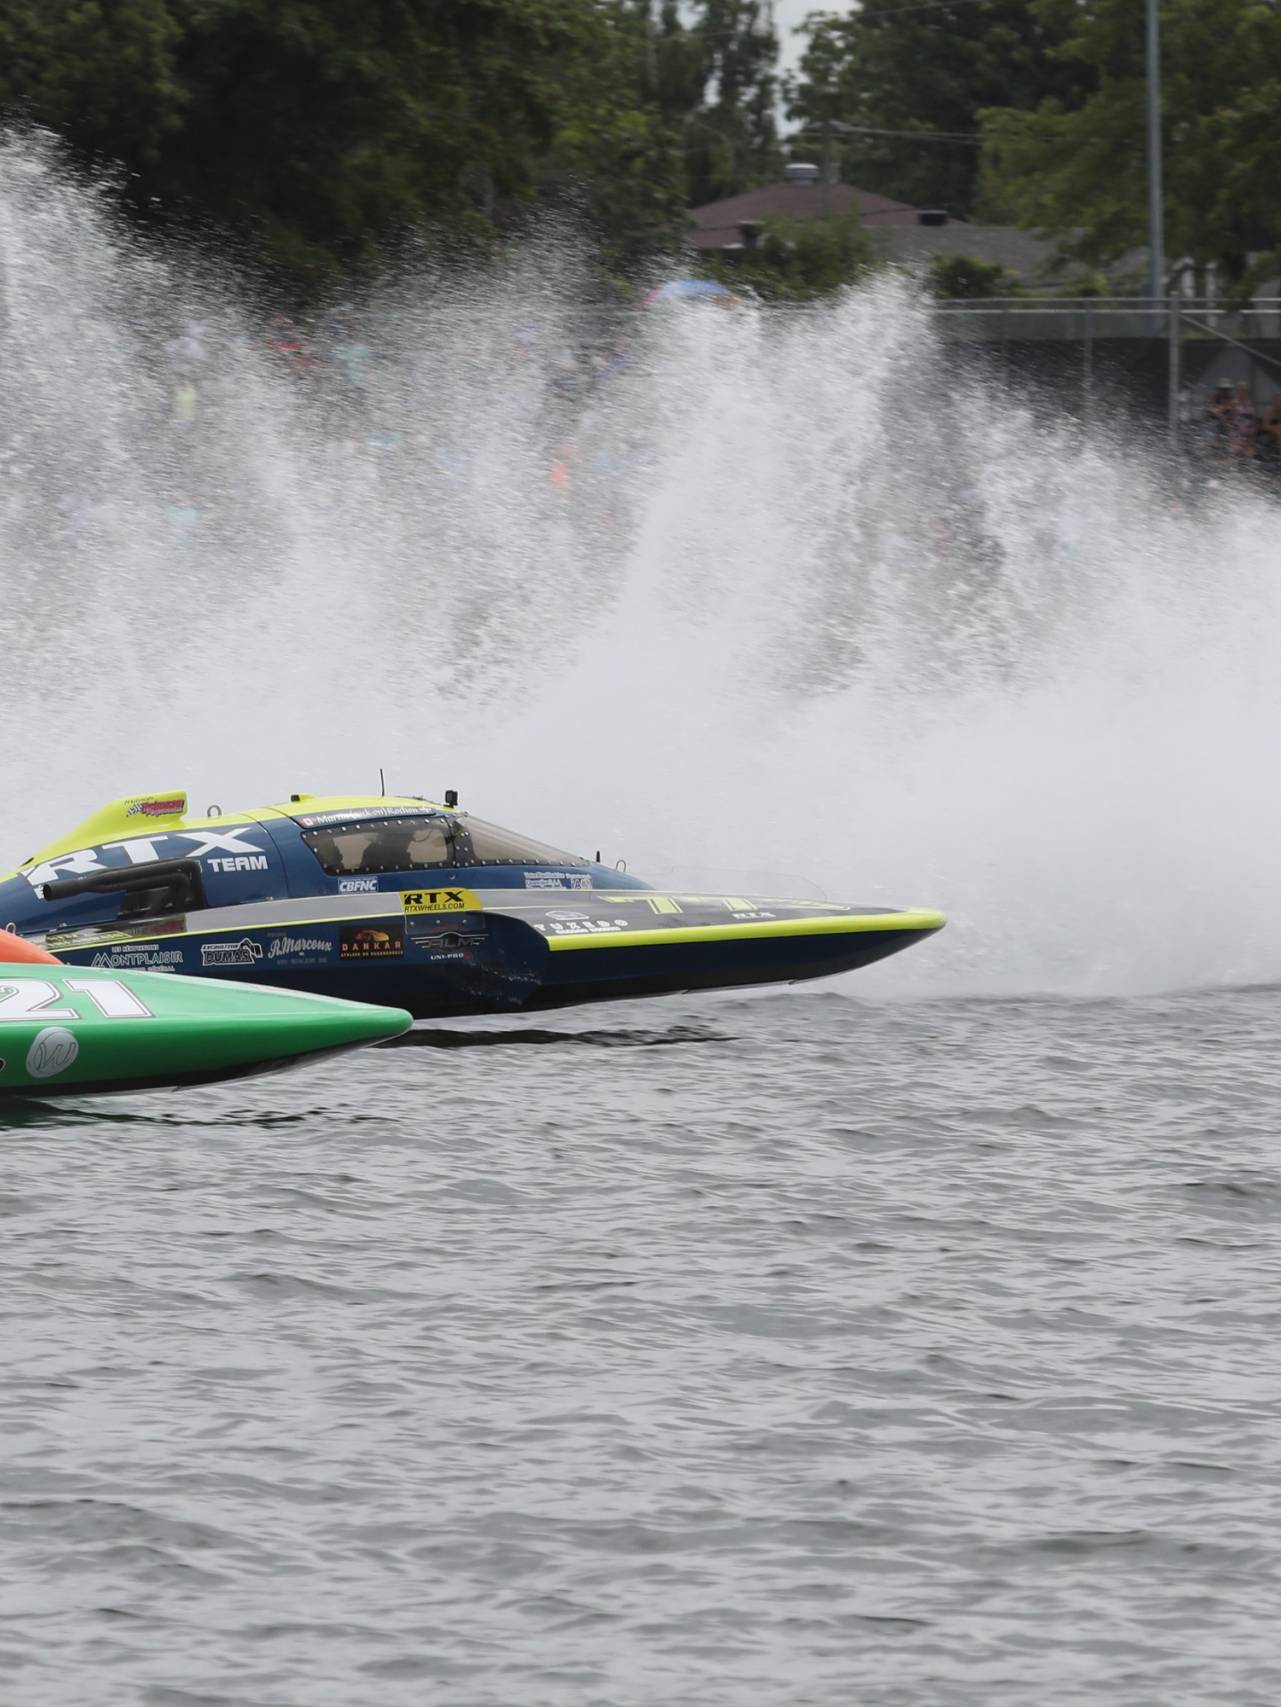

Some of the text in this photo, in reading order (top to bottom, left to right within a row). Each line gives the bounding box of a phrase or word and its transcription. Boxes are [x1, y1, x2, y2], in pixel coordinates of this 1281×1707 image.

[21, 827, 266, 899] RTX
[207, 856, 268, 872] TEAM
[339, 879, 378, 892] CBFNC
[404, 891, 464, 904] RTX
[404, 902, 465, 912] RTXWHEELS.COM
[91, 951, 184, 969] MONTPLAISIR
[204, 950, 253, 965] DUMAS
